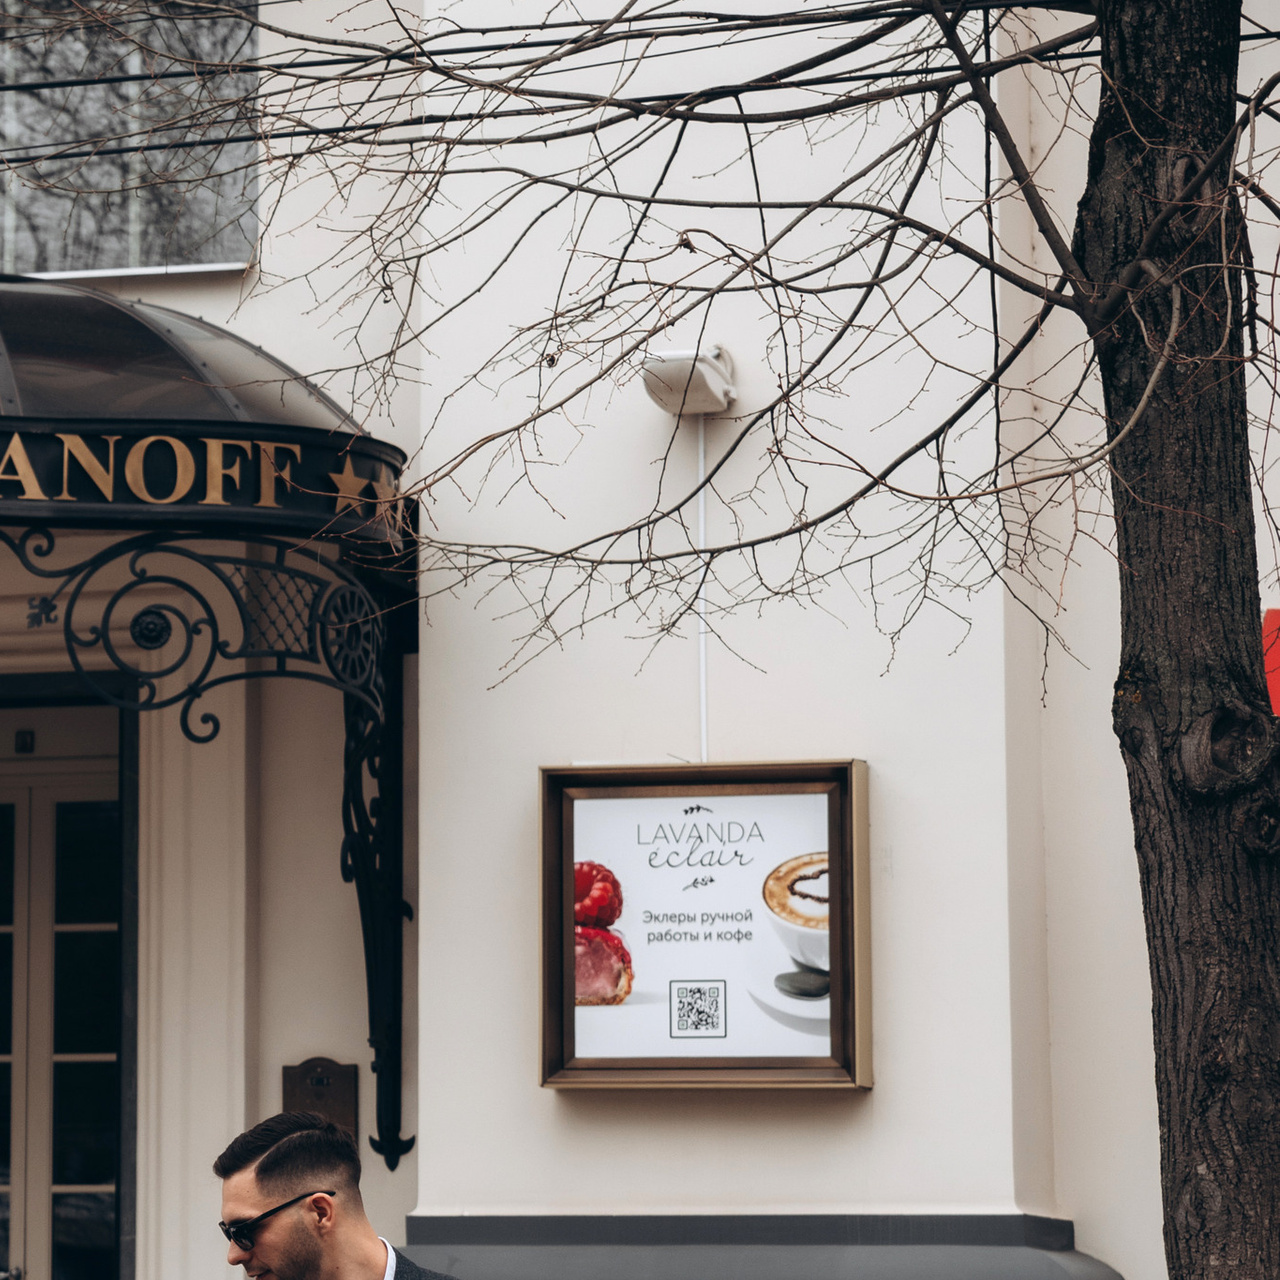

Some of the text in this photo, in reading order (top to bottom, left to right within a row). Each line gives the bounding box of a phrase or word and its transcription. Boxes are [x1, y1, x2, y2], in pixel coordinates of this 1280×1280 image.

[637, 821, 765, 845] LAVANDA
[648, 835, 754, 868] éclair
[642, 908, 753, 926] Эклеры ручной
[647, 928, 753, 945] работы и кофе
